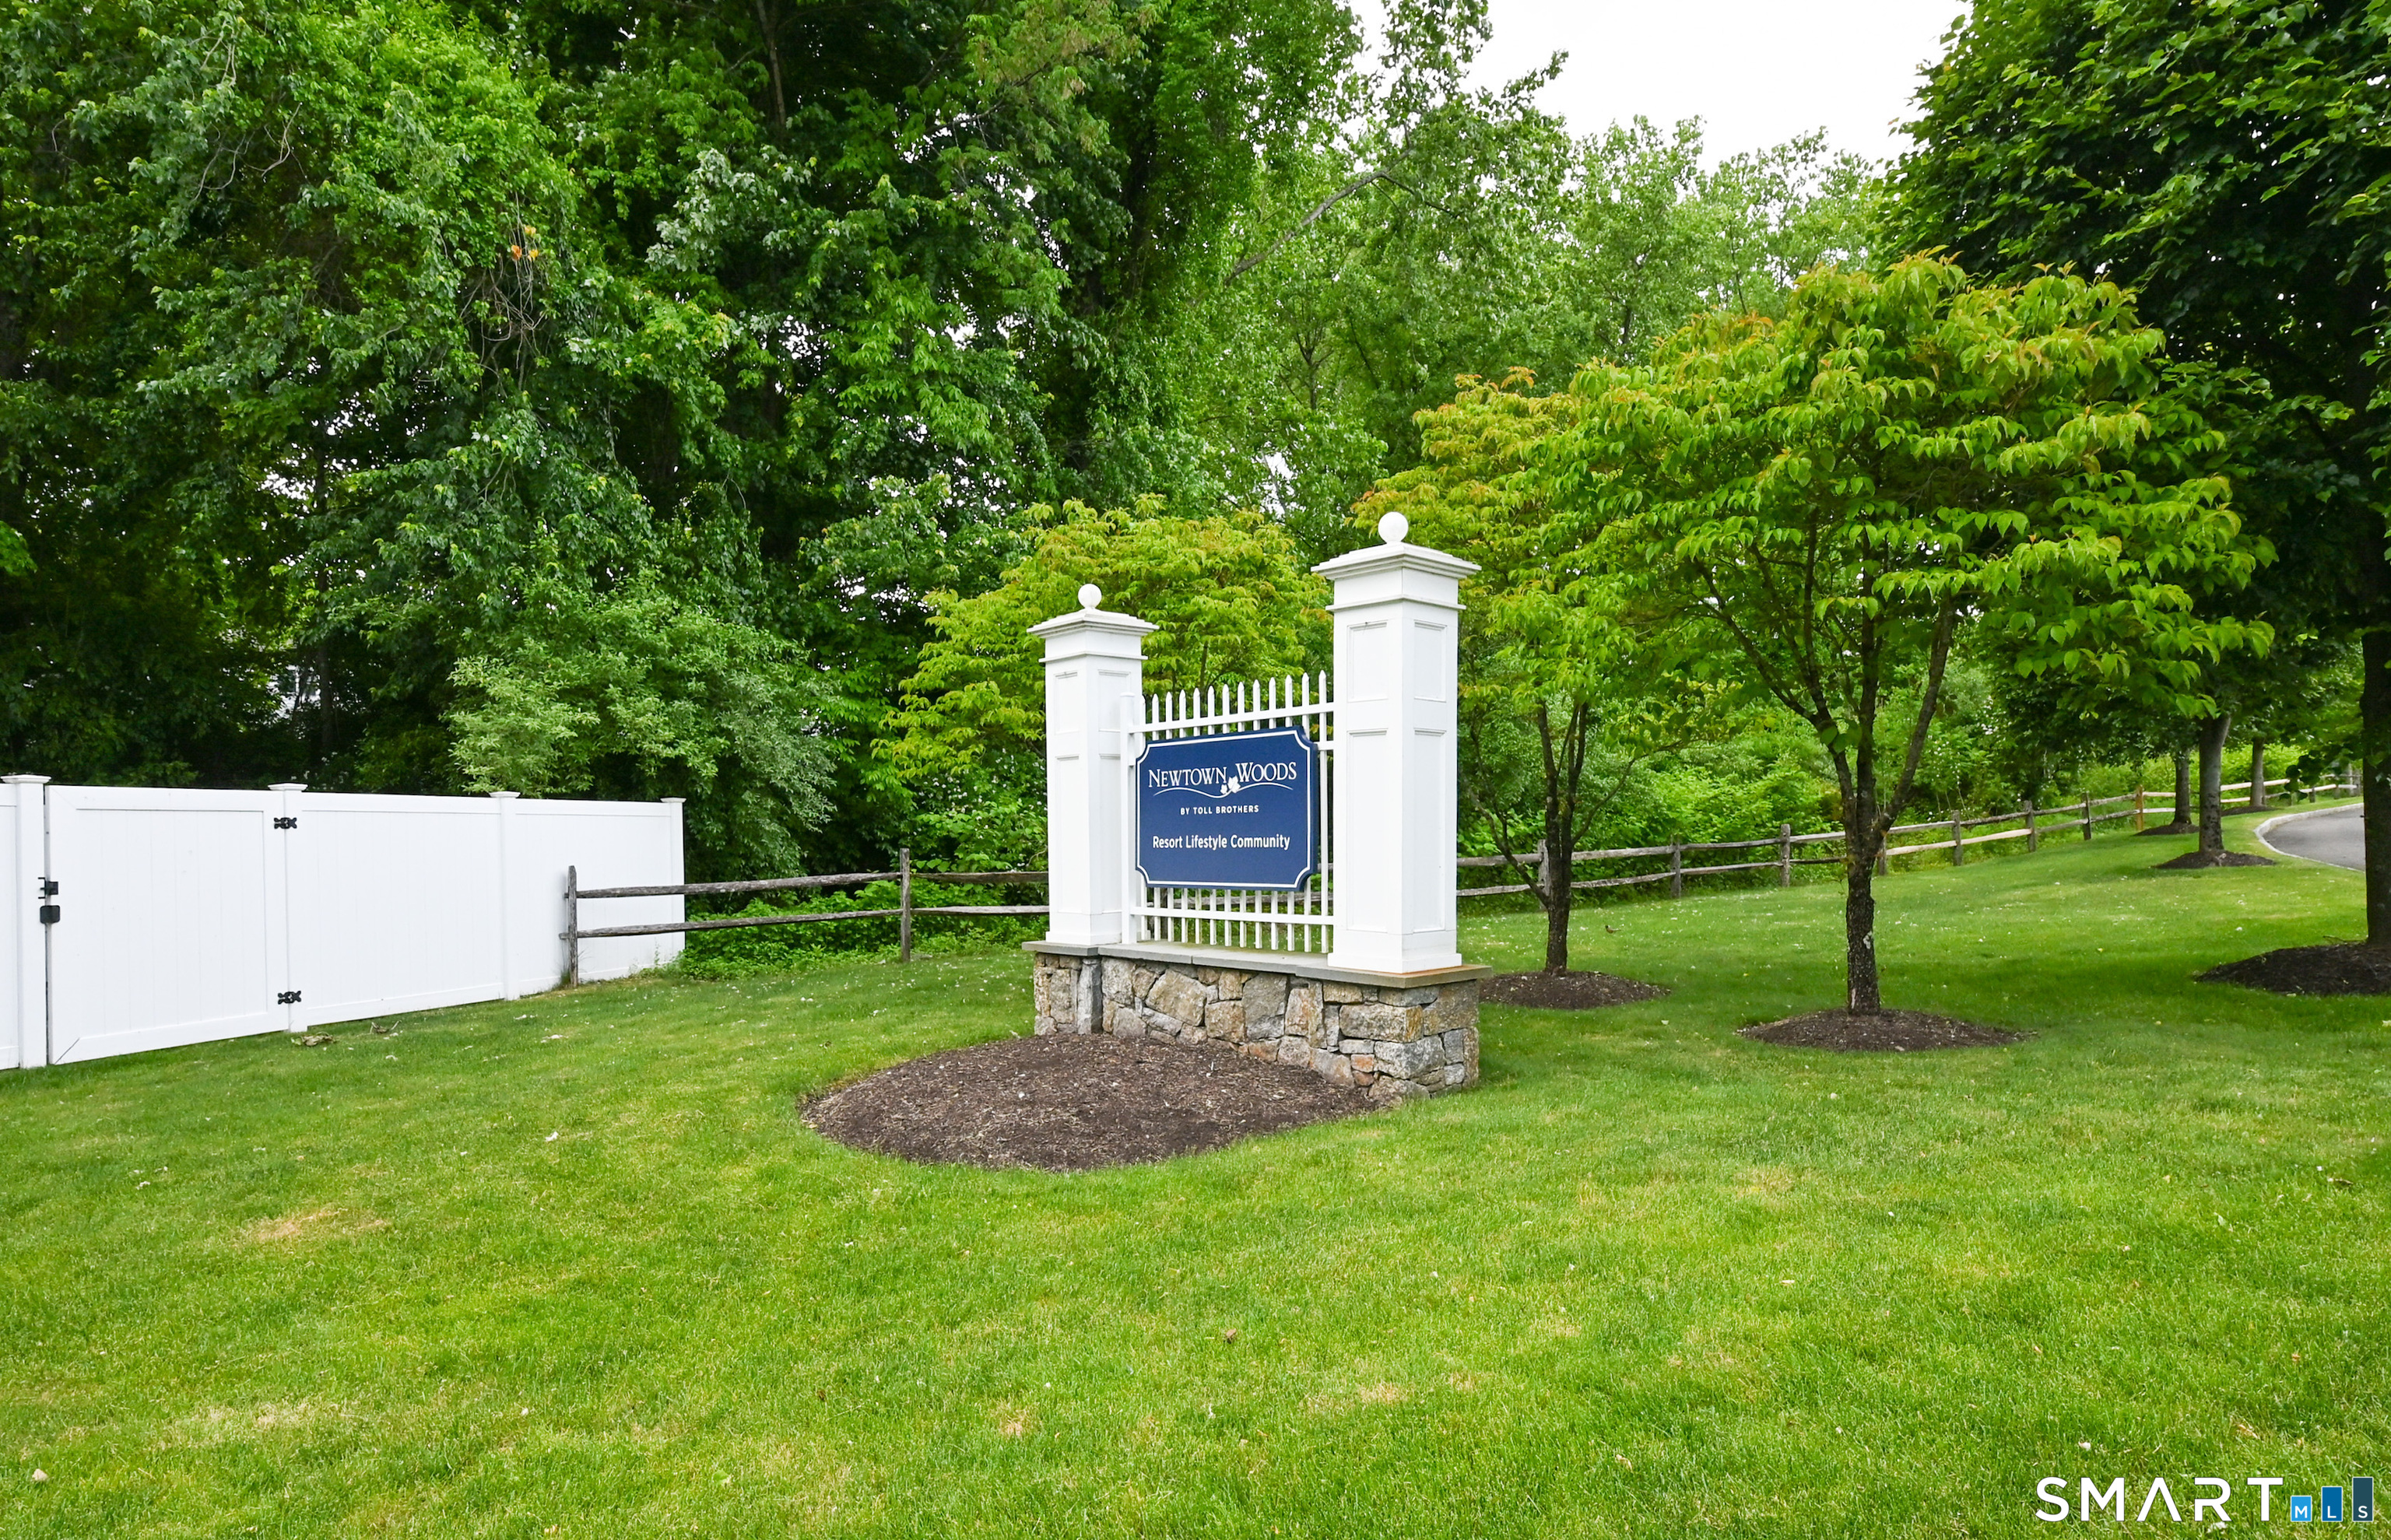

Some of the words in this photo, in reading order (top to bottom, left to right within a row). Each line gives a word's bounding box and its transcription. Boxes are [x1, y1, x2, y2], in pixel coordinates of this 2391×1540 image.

[1148, 766, 1227, 788] NEWTOWN
[1235, 762, 1297, 782] WOODS
[1193, 806, 1213, 815] TOLL
[1216, 805, 1259, 814] BROTHERS
[1153, 835, 1183, 848] Resort
[1185, 834, 1227, 851] Lifestyle
[1231, 833, 1290, 851] Community
